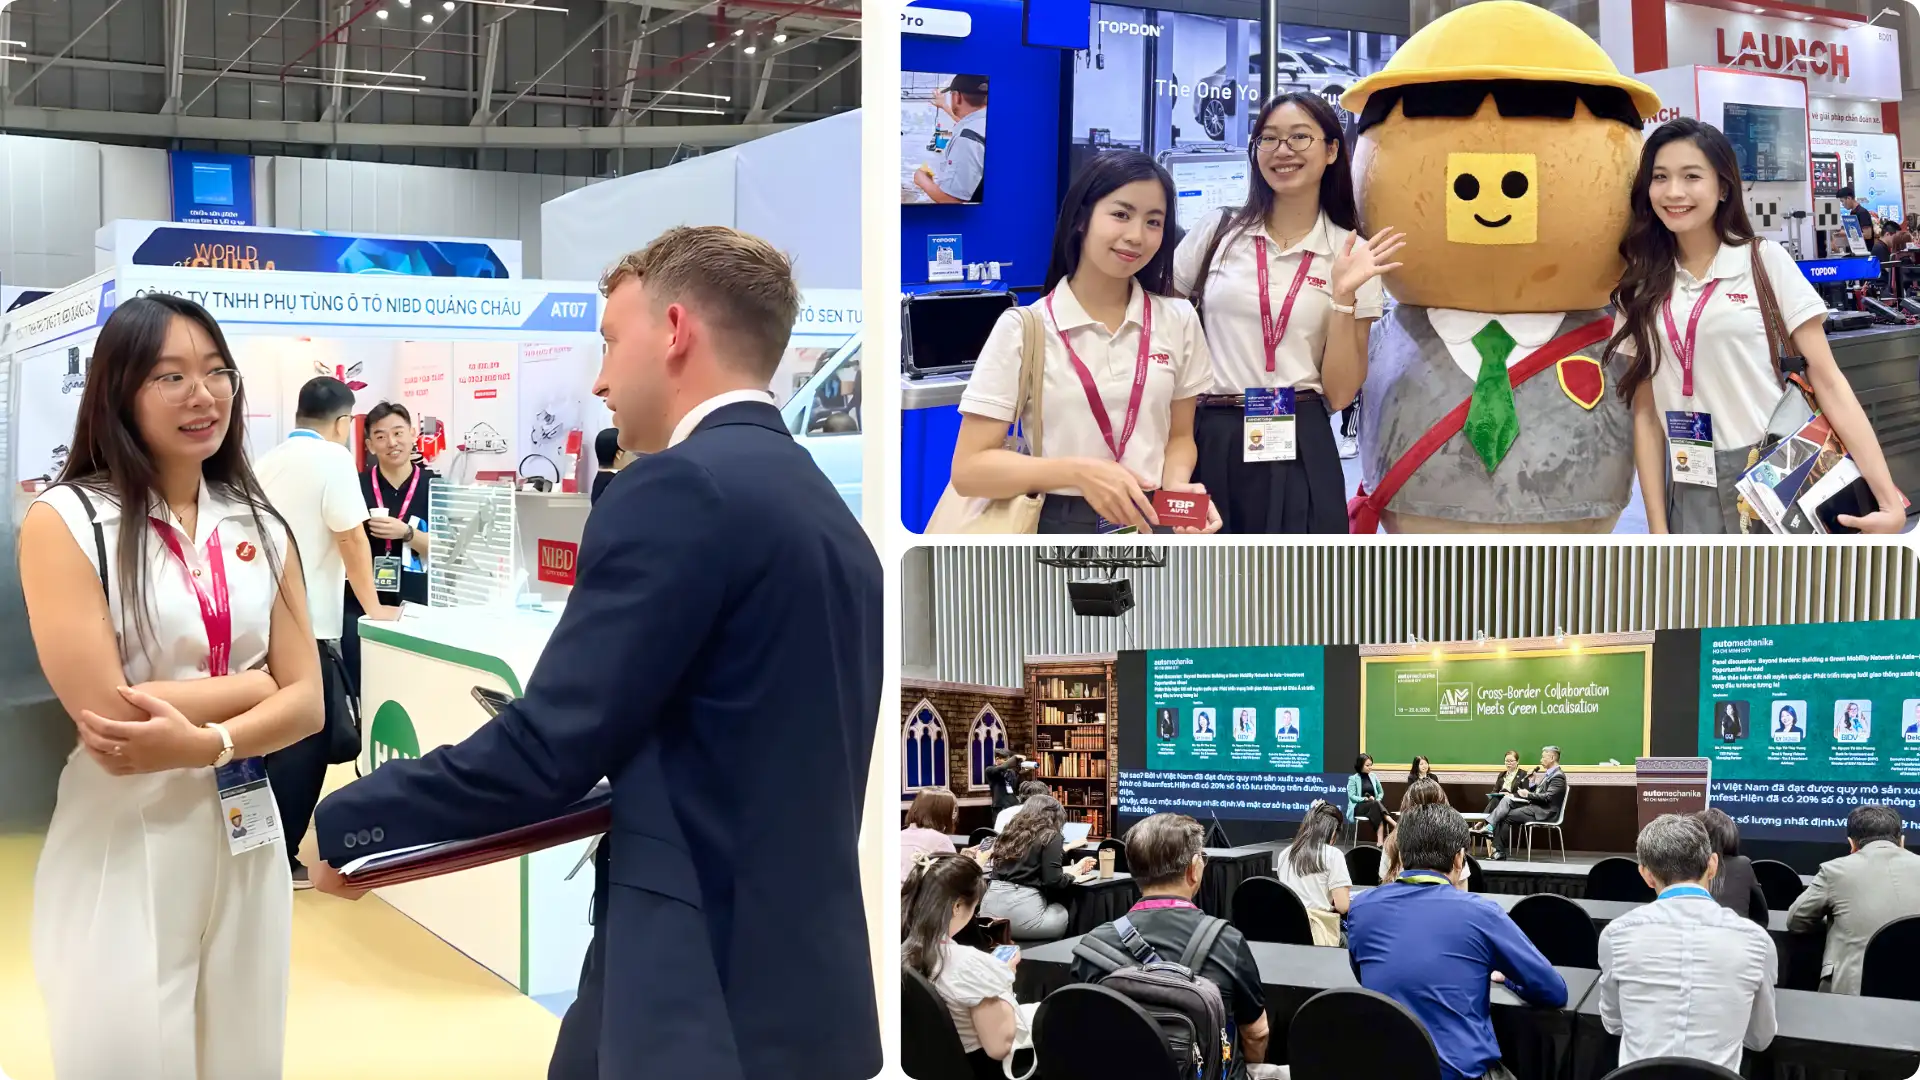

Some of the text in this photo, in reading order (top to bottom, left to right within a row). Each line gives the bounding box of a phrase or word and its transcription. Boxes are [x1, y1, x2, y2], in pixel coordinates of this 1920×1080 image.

[1098, 20, 1160, 38] TOPDON
[1716, 28, 1850, 78] LAUNCH
[1155, 79, 1191, 98] The
[1197, 82, 1232, 100] One
[1237, 84, 1258, 102] Yo
[194, 243, 258, 262] WORLD
[1811, 266, 1837, 276] TOPDON
[213, 291, 259, 310] TNHH
[264, 292, 297, 314] PHỤ
[300, 290, 344, 312] TÙNG
[386, 297, 422, 313] NIBD
[425, 294, 477, 316] QUẢNG
[481, 297, 522, 317] CHÂU
[551, 301, 588, 318] AT07
[818, 308, 843, 323] SEN
[1166, 498, 1195, 509] TBP
[1169, 507, 1190, 515] AUTO
[541, 545, 574, 571] NIBD
[1713, 638, 1774, 648] automechanika
[1477, 681, 1610, 700] Cross-Border Collaboration
[1477, 700, 1505, 716] Meets
[1508, 701, 1538, 716] Green
[1541, 698, 1600, 716] Localisation
[1129, 772, 1143, 780] sao?
[1236, 774, 1249, 783] quy
[1200, 781, 1210, 789] có
[1210, 782, 1226, 790] 20%
[1263, 783, 1286, 793] thông
[1711, 782, 1720, 791] vì
[1722, 782, 1743, 792] Việt
[1744, 783, 1770, 792] Nam
[1771, 783, 1785, 792] đã
[1787, 783, 1805, 794] đạt
[1806, 783, 1835, 795] được
[1836, 785, 1858, 796] quy
[1860, 784, 1879, 794] mô
[1173, 797, 1181, 806] số
[1765, 794, 1780, 803] đã
[1781, 794, 1794, 803] có
[1795, 795, 1819, 804] 20%
[1820, 795, 1835, 804] số
[1836, 795, 1844, 804] ô
[1845, 796, 1859, 805] tô
[1881, 797, 1916, 808] thông
[1737, 814, 1750, 824] số
[1751, 815, 1782, 827] lượng
[1784, 815, 1809, 826] nhất
